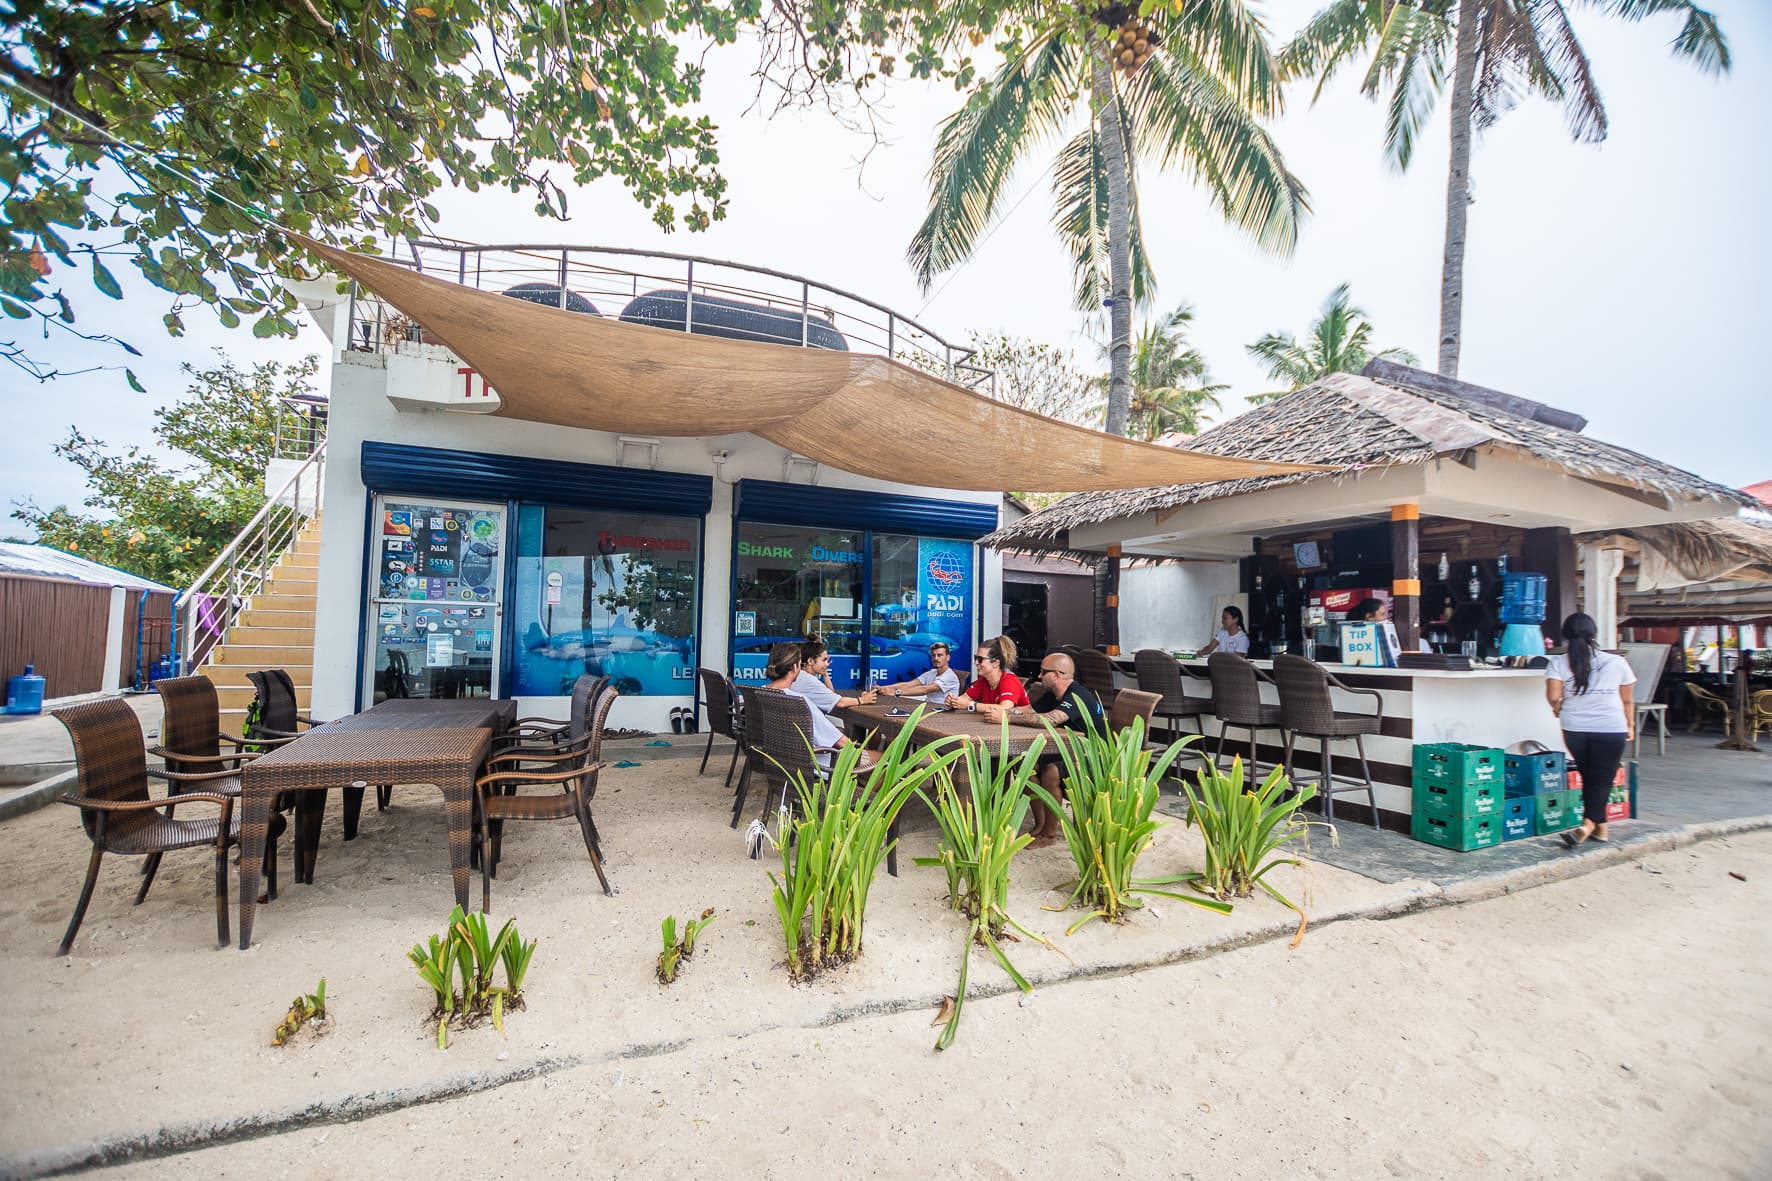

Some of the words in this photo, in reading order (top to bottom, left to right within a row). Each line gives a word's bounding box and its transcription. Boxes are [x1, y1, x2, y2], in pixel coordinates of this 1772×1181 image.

[430, 544, 448, 552] PADI
[738, 541, 793, 558] SHARK
[927, 593, 964, 611] PADI
[1349, 630, 1368, 639] TIP
[1348, 642, 1373, 652] BOX
[849, 668, 888, 680] HRE
